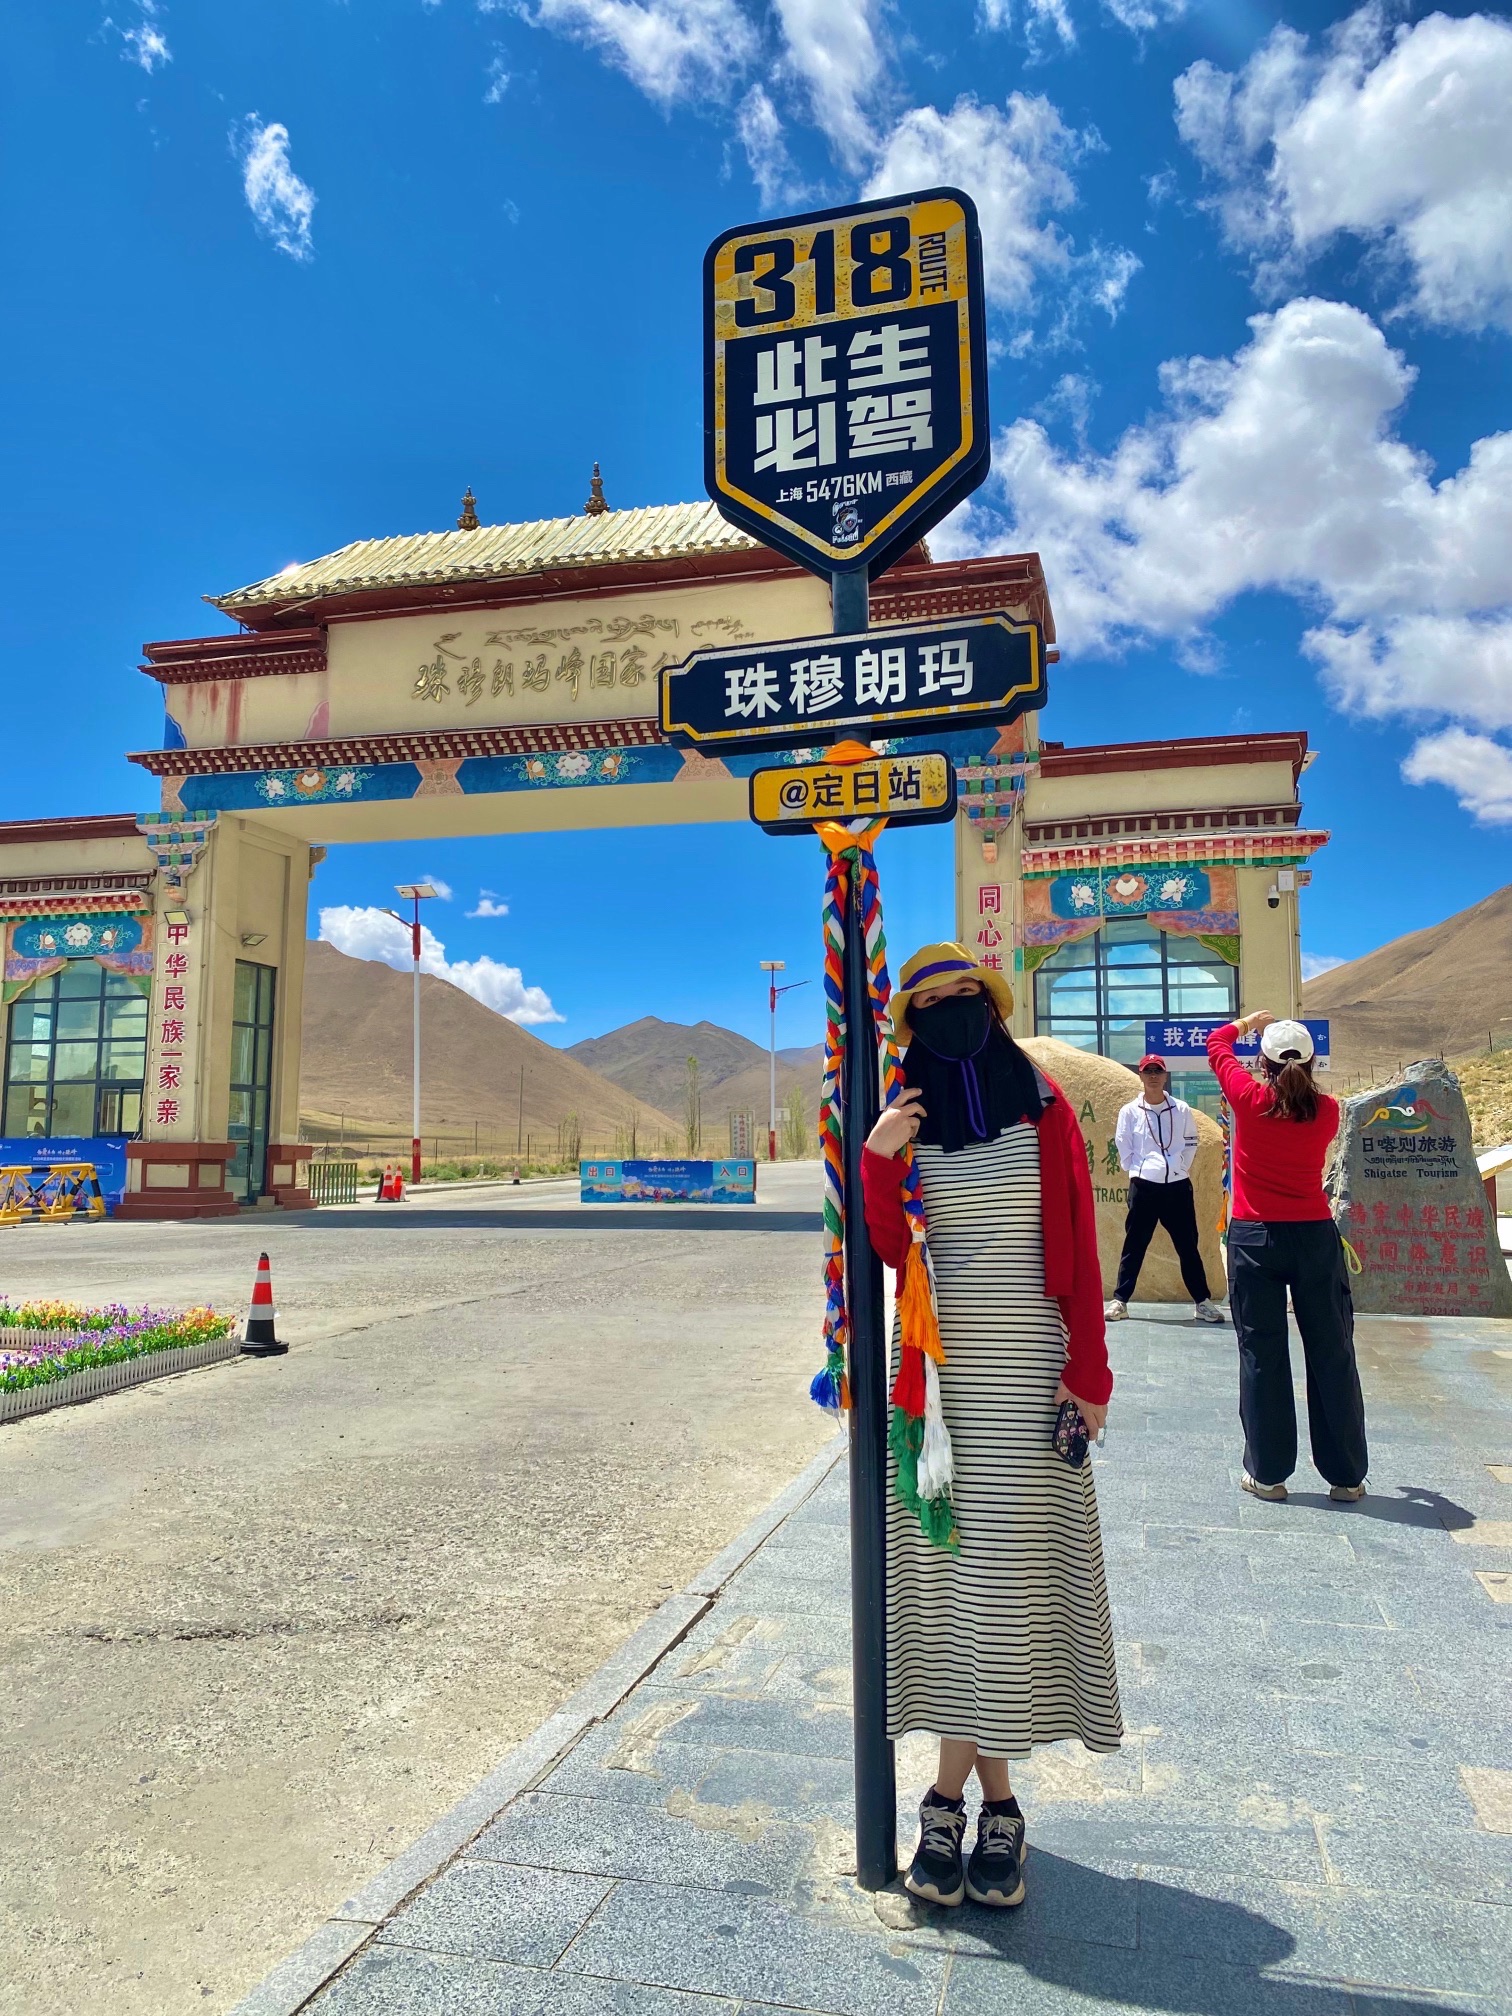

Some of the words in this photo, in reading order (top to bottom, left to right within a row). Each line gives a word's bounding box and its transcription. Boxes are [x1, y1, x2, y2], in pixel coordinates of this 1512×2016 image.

[734, 217, 912, 328] 318
[918, 232, 948, 296] ROUTE
[753, 324, 931, 405] 此生
[754, 388, 933, 474] 必驾
[776, 487, 803, 503] 上海
[806, 470, 882, 503] 5476KM
[886, 470, 913, 487] 西藏
[724, 638, 975, 719] 珠穆朗玛
[780, 766, 922, 809] @定日站
[1163, 1026, 1258, 1047] 我在峰
[1362, 1135, 1457, 1153] 日喀则旅游
[588, 1166, 615, 1178] 出口
[720, 1166, 748, 1177] 入口
[1364, 1168, 1408, 1179] Shigatse
[1416, 1168, 1458, 1178] Tourism
